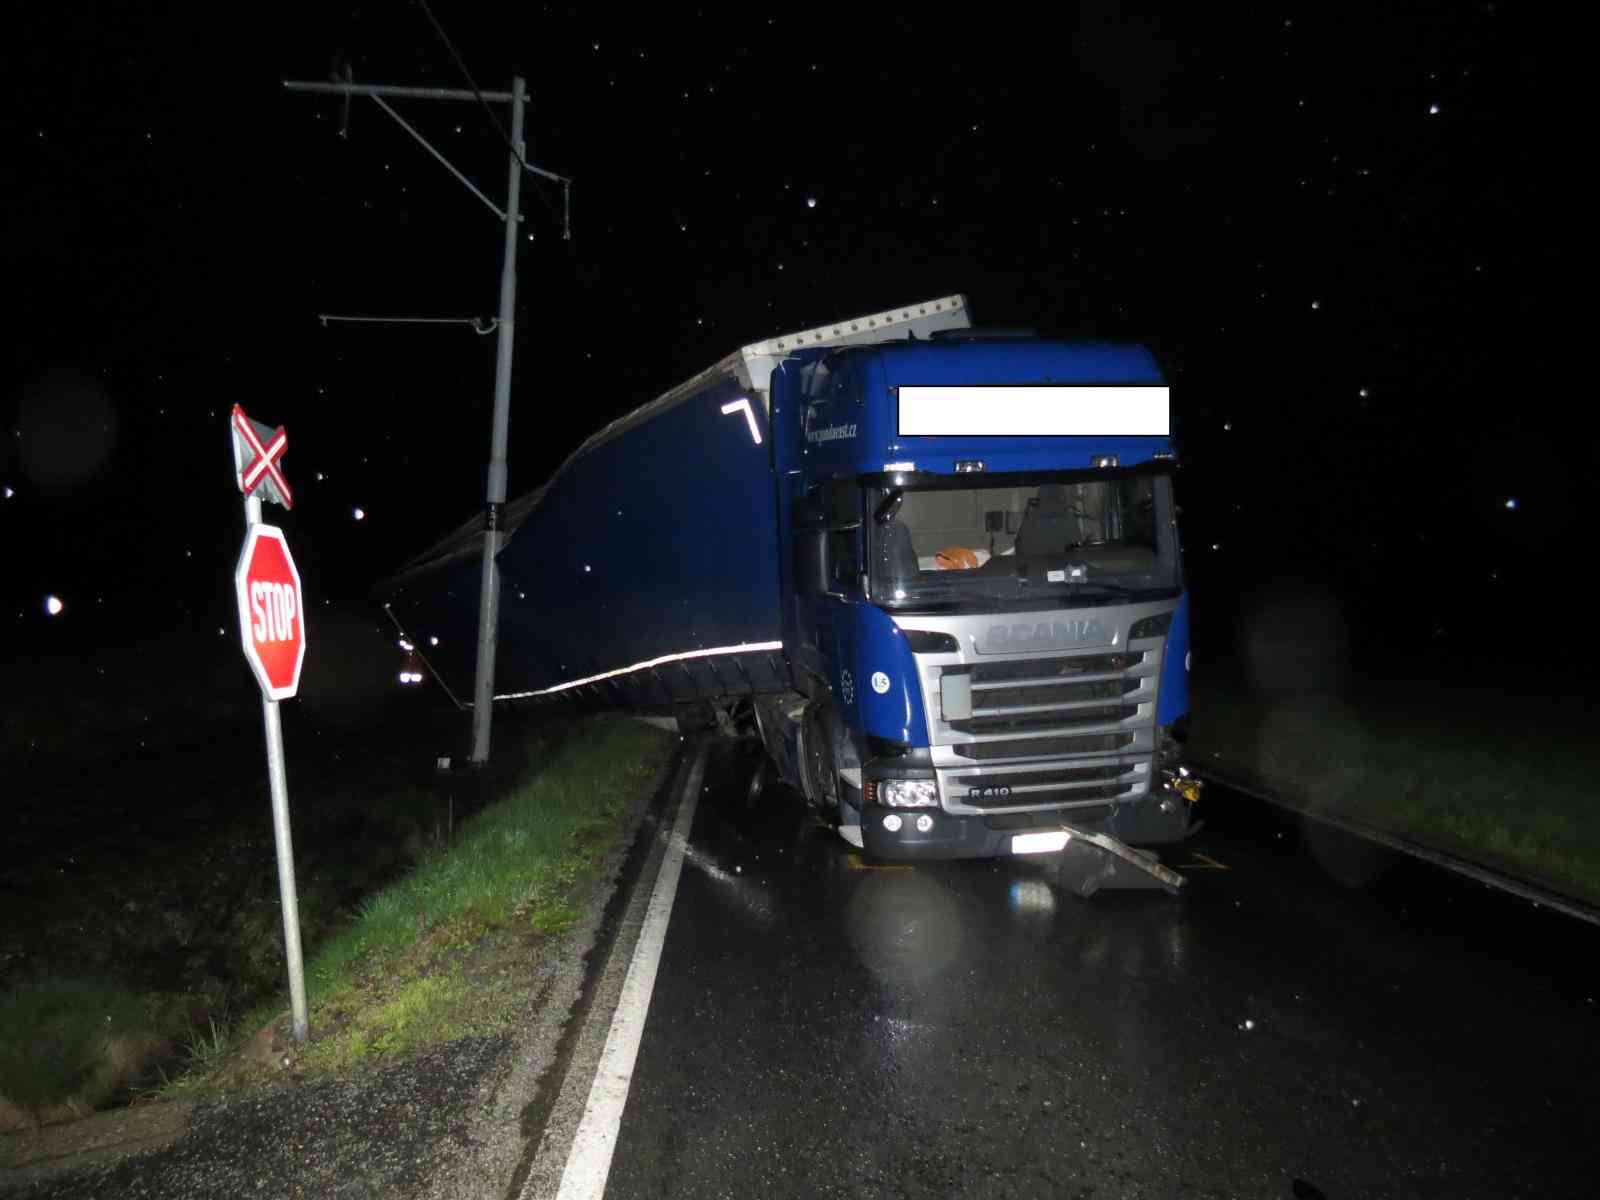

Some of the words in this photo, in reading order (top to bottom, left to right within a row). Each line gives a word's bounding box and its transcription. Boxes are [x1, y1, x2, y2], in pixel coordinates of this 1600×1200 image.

[251, 581, 296, 642] STOP
[970, 788, 981, 798] R
[983, 786, 1010, 797] 410
